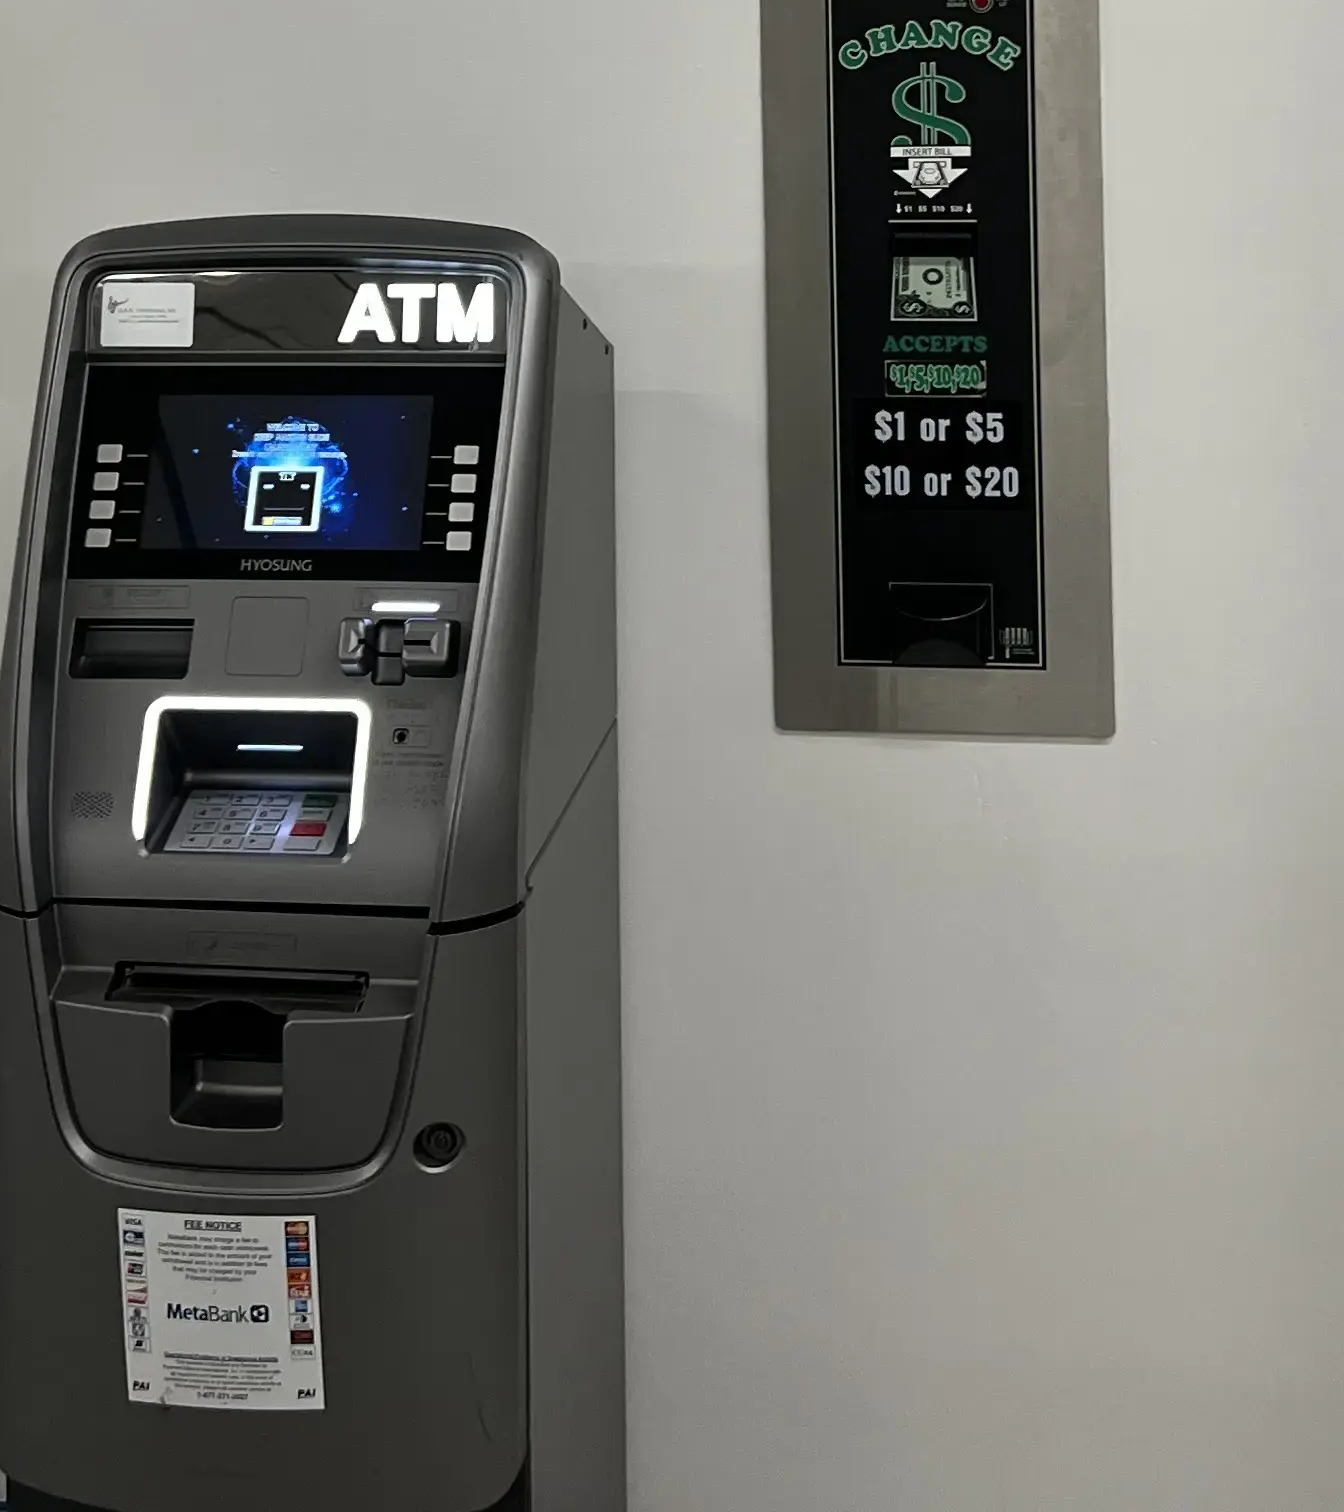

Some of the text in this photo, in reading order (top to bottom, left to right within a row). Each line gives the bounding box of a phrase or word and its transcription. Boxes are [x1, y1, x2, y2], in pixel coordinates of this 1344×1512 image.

[838, 19, 1022, 71] CHANGE
[902, 147, 953, 156] INSERT BILL
[337, 282, 494, 345] ATM
[883, 335, 988, 353] ACCEPTS
[874, 409, 1005, 444] $1 or $5
[864, 464, 1019, 499] $10 or $20
[240, 559, 313, 572] HYOSUNG
[184, 1219, 242, 1231] FEE NOTICE
[167, 1303, 249, 1323] MetaBank
